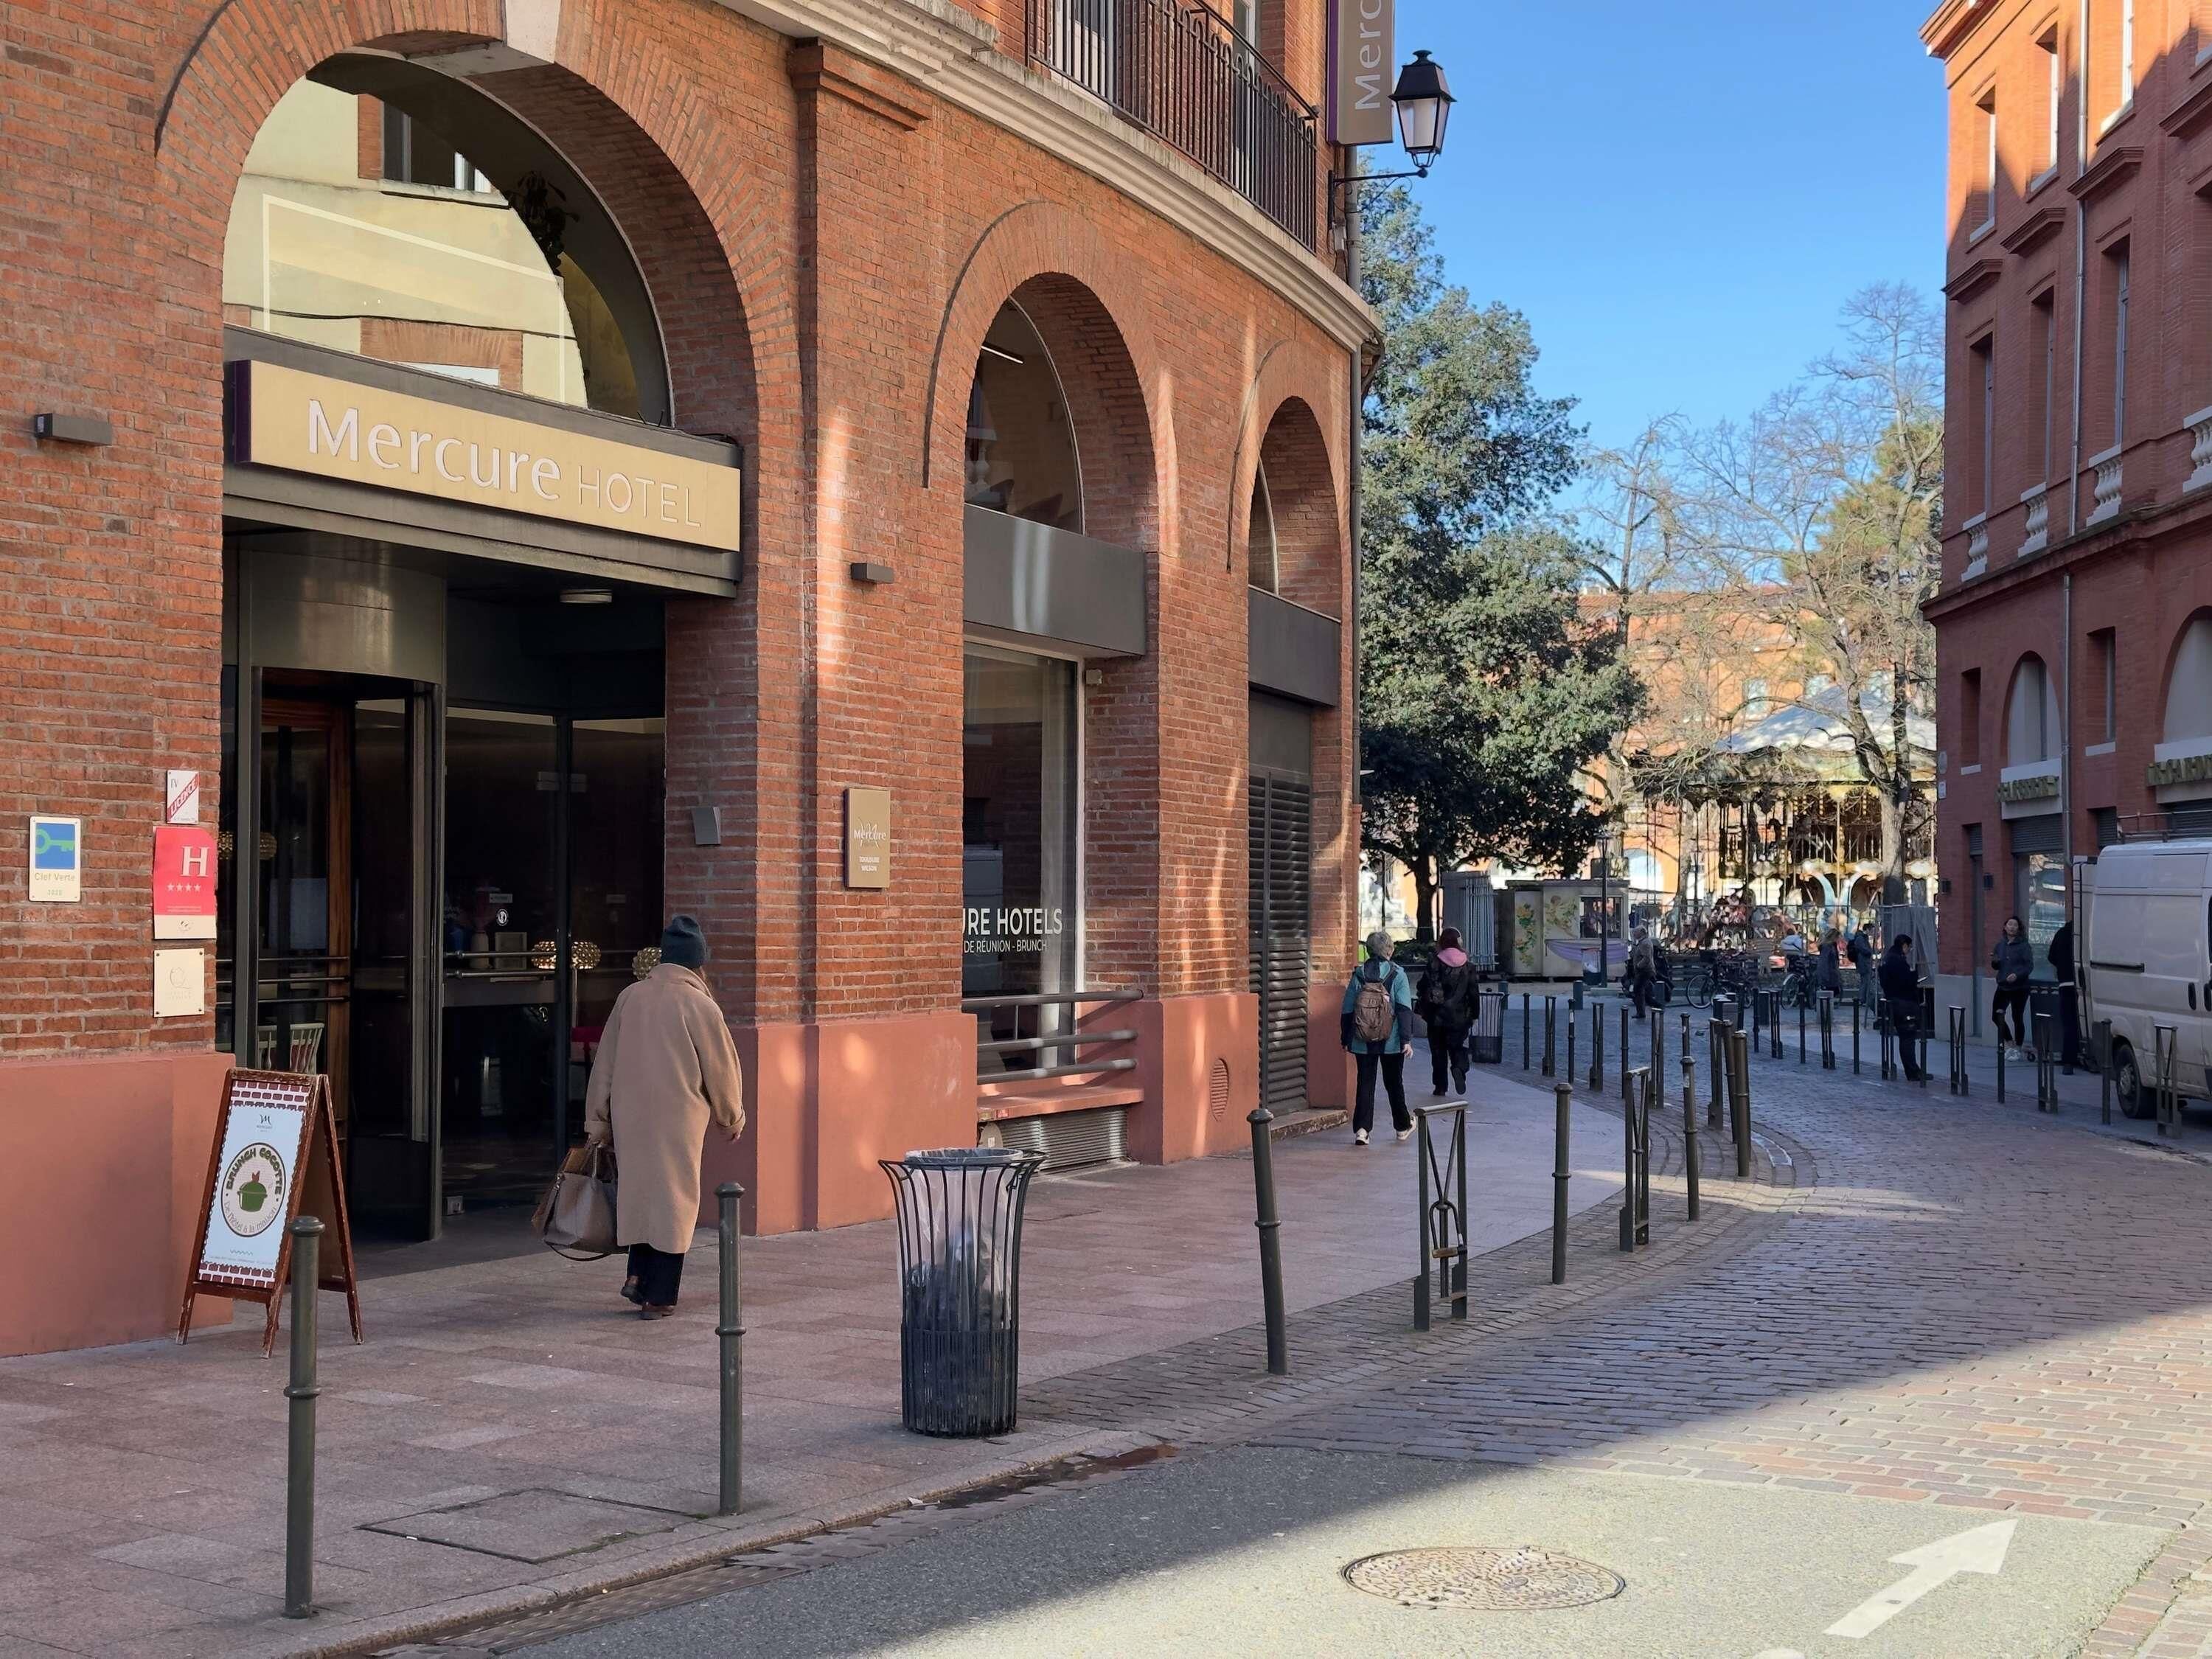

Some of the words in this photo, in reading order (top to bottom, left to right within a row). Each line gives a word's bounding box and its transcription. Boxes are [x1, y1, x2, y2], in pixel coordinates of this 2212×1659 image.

[308, 399, 561, 501] Mercure
[578, 465, 701, 528] HOTEL
[170, 776, 198, 816] LICENCE
[854, 830, 886, 841] Mercure
[34, 872, 51, 880] Clef
[180, 846, 209, 877] H
[997, 908, 1062, 935] HOTELS
[964, 940, 975, 953] DE
[976, 938, 1011, 953] RÉUNION
[1016, 939, 1047, 952] BRUNCH
[226, 1148, 257, 1190] BRUNCH
[259, 1147, 283, 1195] COCOTTE
